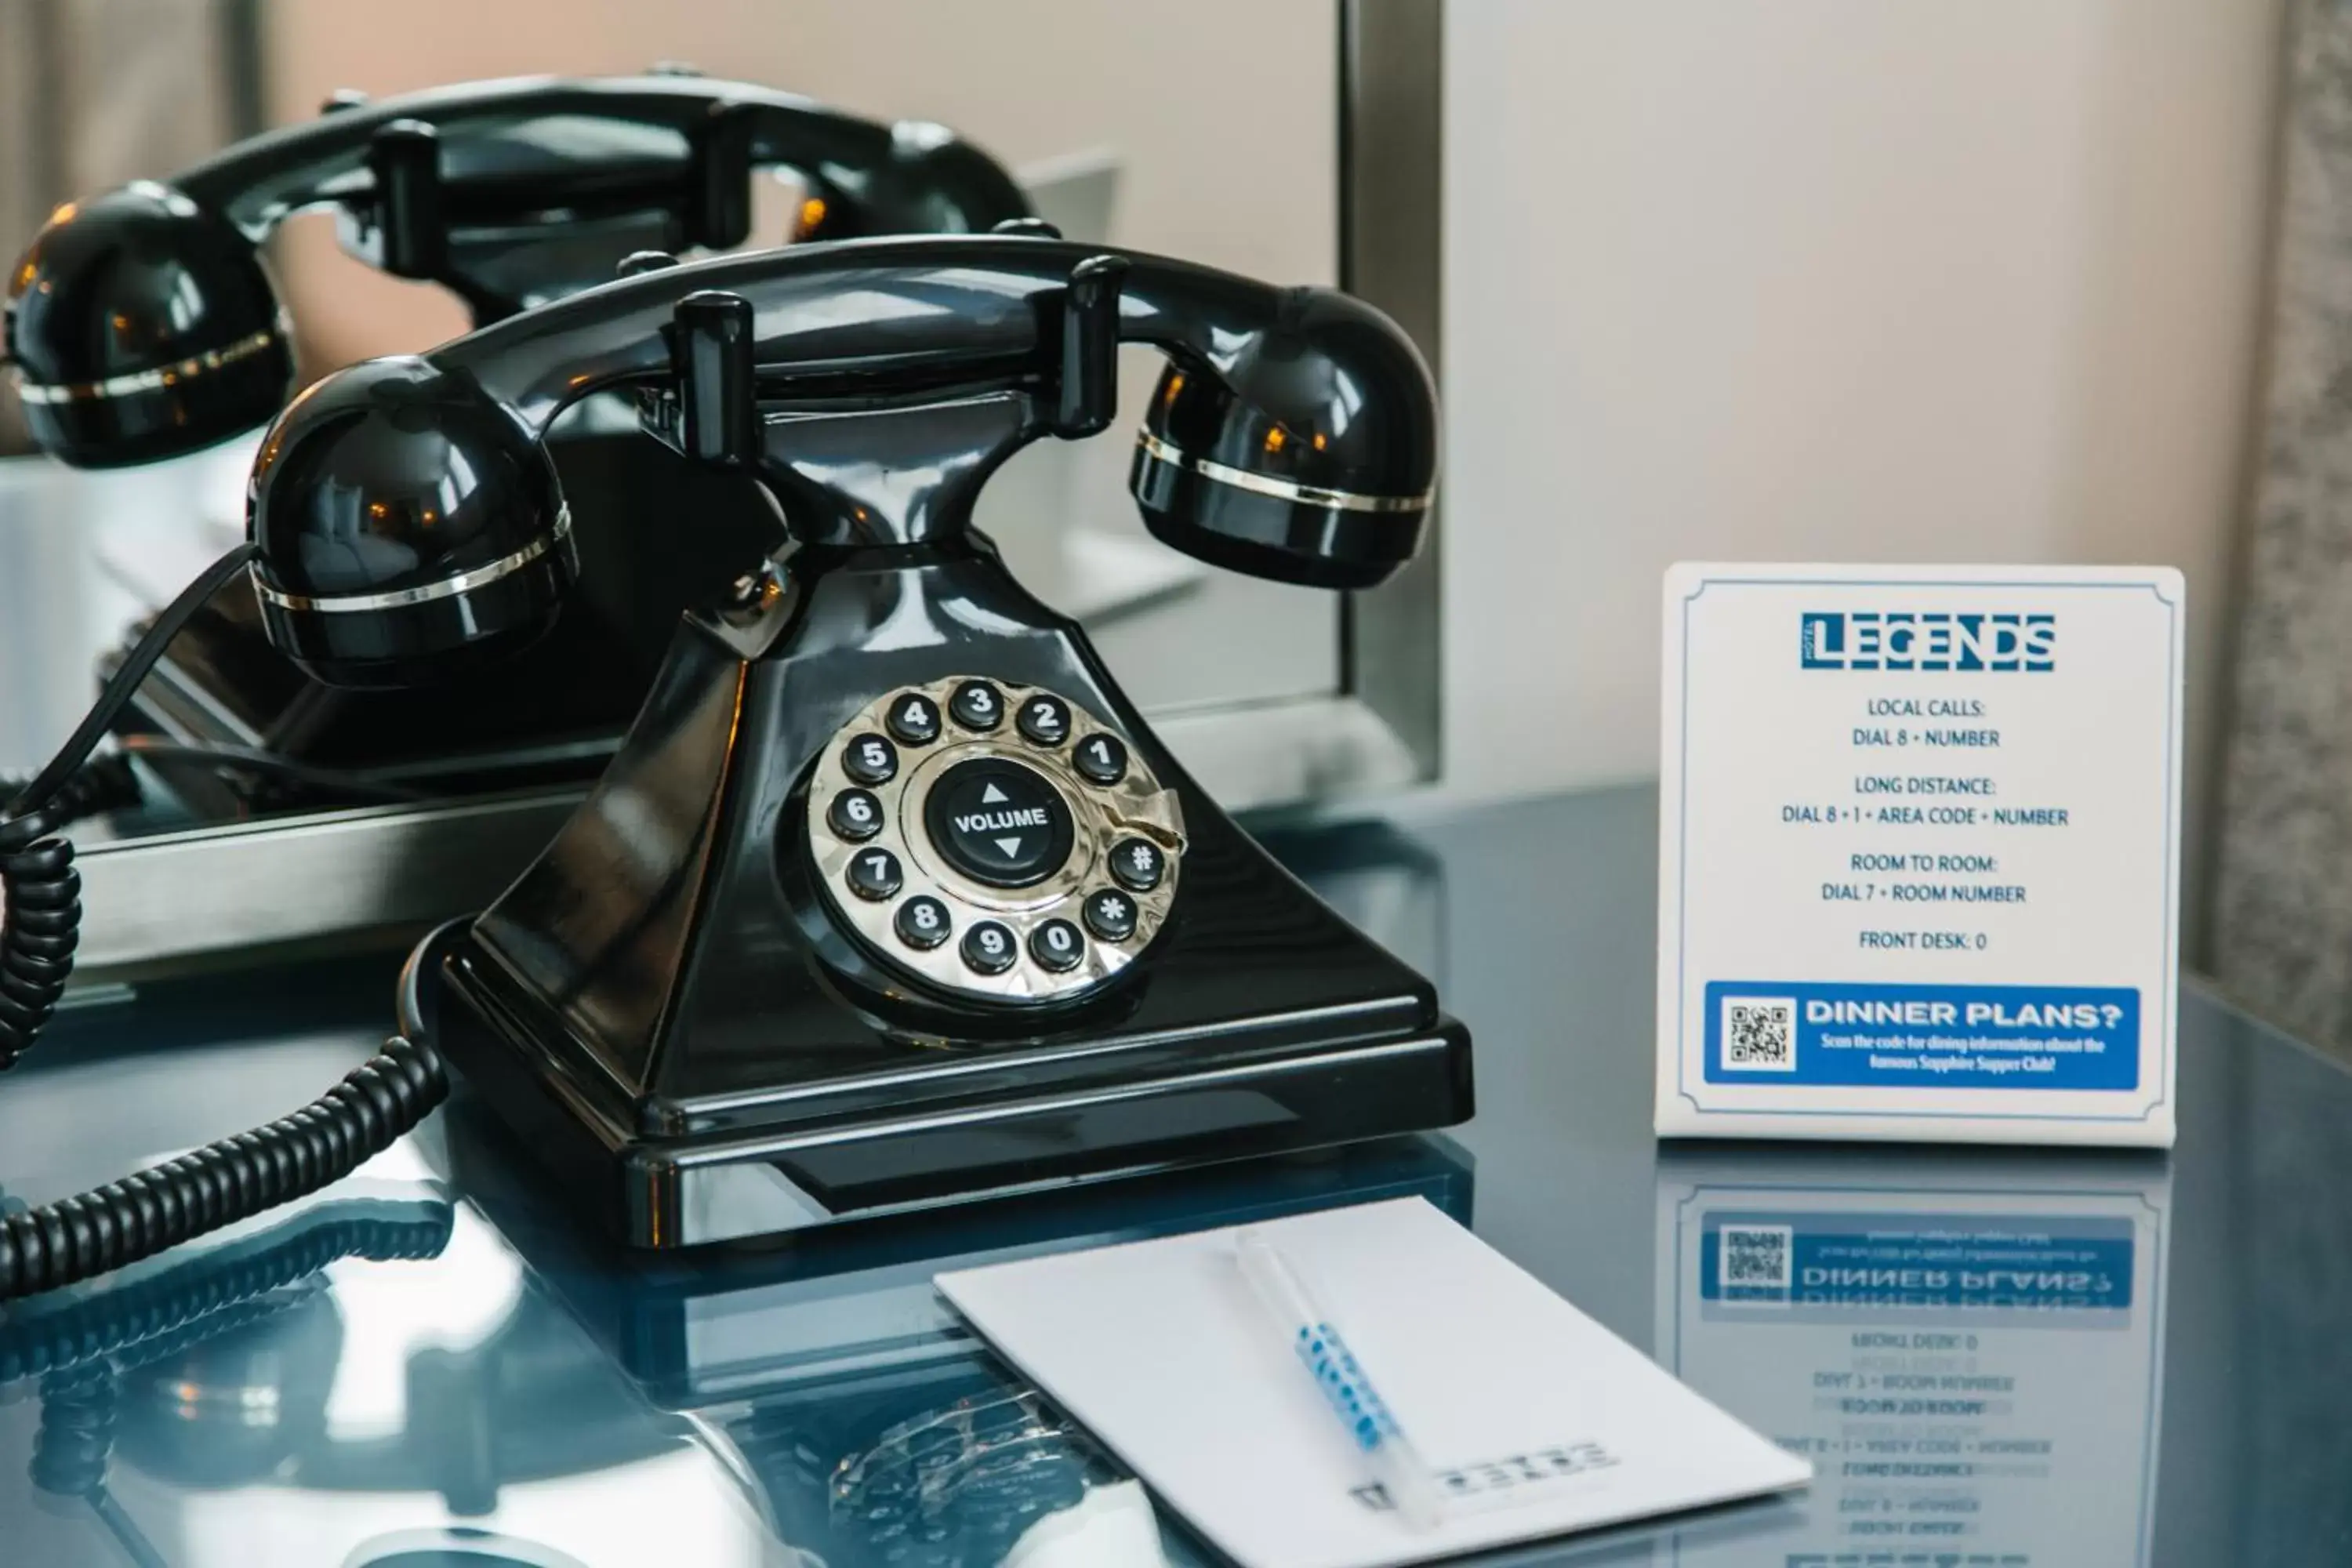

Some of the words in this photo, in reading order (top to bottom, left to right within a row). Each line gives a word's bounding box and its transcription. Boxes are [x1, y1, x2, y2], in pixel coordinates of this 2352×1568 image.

[1813, 619, 2056, 664] LEGENDS
[967, 688, 993, 712] 3
[1868, 699, 1922, 716] LOCAL
[1928, 699, 1987, 717] CALLS:
[904, 702, 927, 725] 4
[1033, 703, 1058, 728] 2
[1853, 728, 1892, 746] DIAL
[1896, 729, 1907, 746] 8
[1926, 730, 2000, 747] NUMBER
[863, 742, 887, 767] 5
[1091, 741, 1111, 765] 1
[1855, 776, 1903, 794] LONG
[1907, 777, 1997, 796] DISTANCE:
[848, 797, 872, 822] 6
[954, 808, 1048, 833] VOLUME
[1782, 805, 1821, 823] DIAL
[1826, 806, 1837, 823] 8
[1878, 807, 1924, 824] AREA
[1928, 807, 1976, 825] CODE
[1994, 808, 2069, 826] NUMBER
[865, 855, 887, 880] 7
[1131, 846, 1155, 870] #
[1851, 854, 1905, 871] ROOM
[1910, 854, 1934, 872] TO
[1938, 855, 1998, 873] ROOM:
[1821, 883, 1861, 901] DIAL
[1865, 883, 1875, 901] 7
[1892, 884, 1947, 902] ROOM
[1951, 886, 2026, 903] NUMBER
[914, 905, 938, 929] 8
[980, 930, 1004, 954] 9
[1047, 927, 1071, 951] 0
[1859, 931, 1915, 949] FRONT
[1921, 931, 1971, 949] DESK:
[1976, 932, 1987, 950] 0
[1806, 999, 1958, 1025] DINNER
[1965, 1003, 2124, 1029] PLANS?
[1853, 1033, 1875, 1049] the
